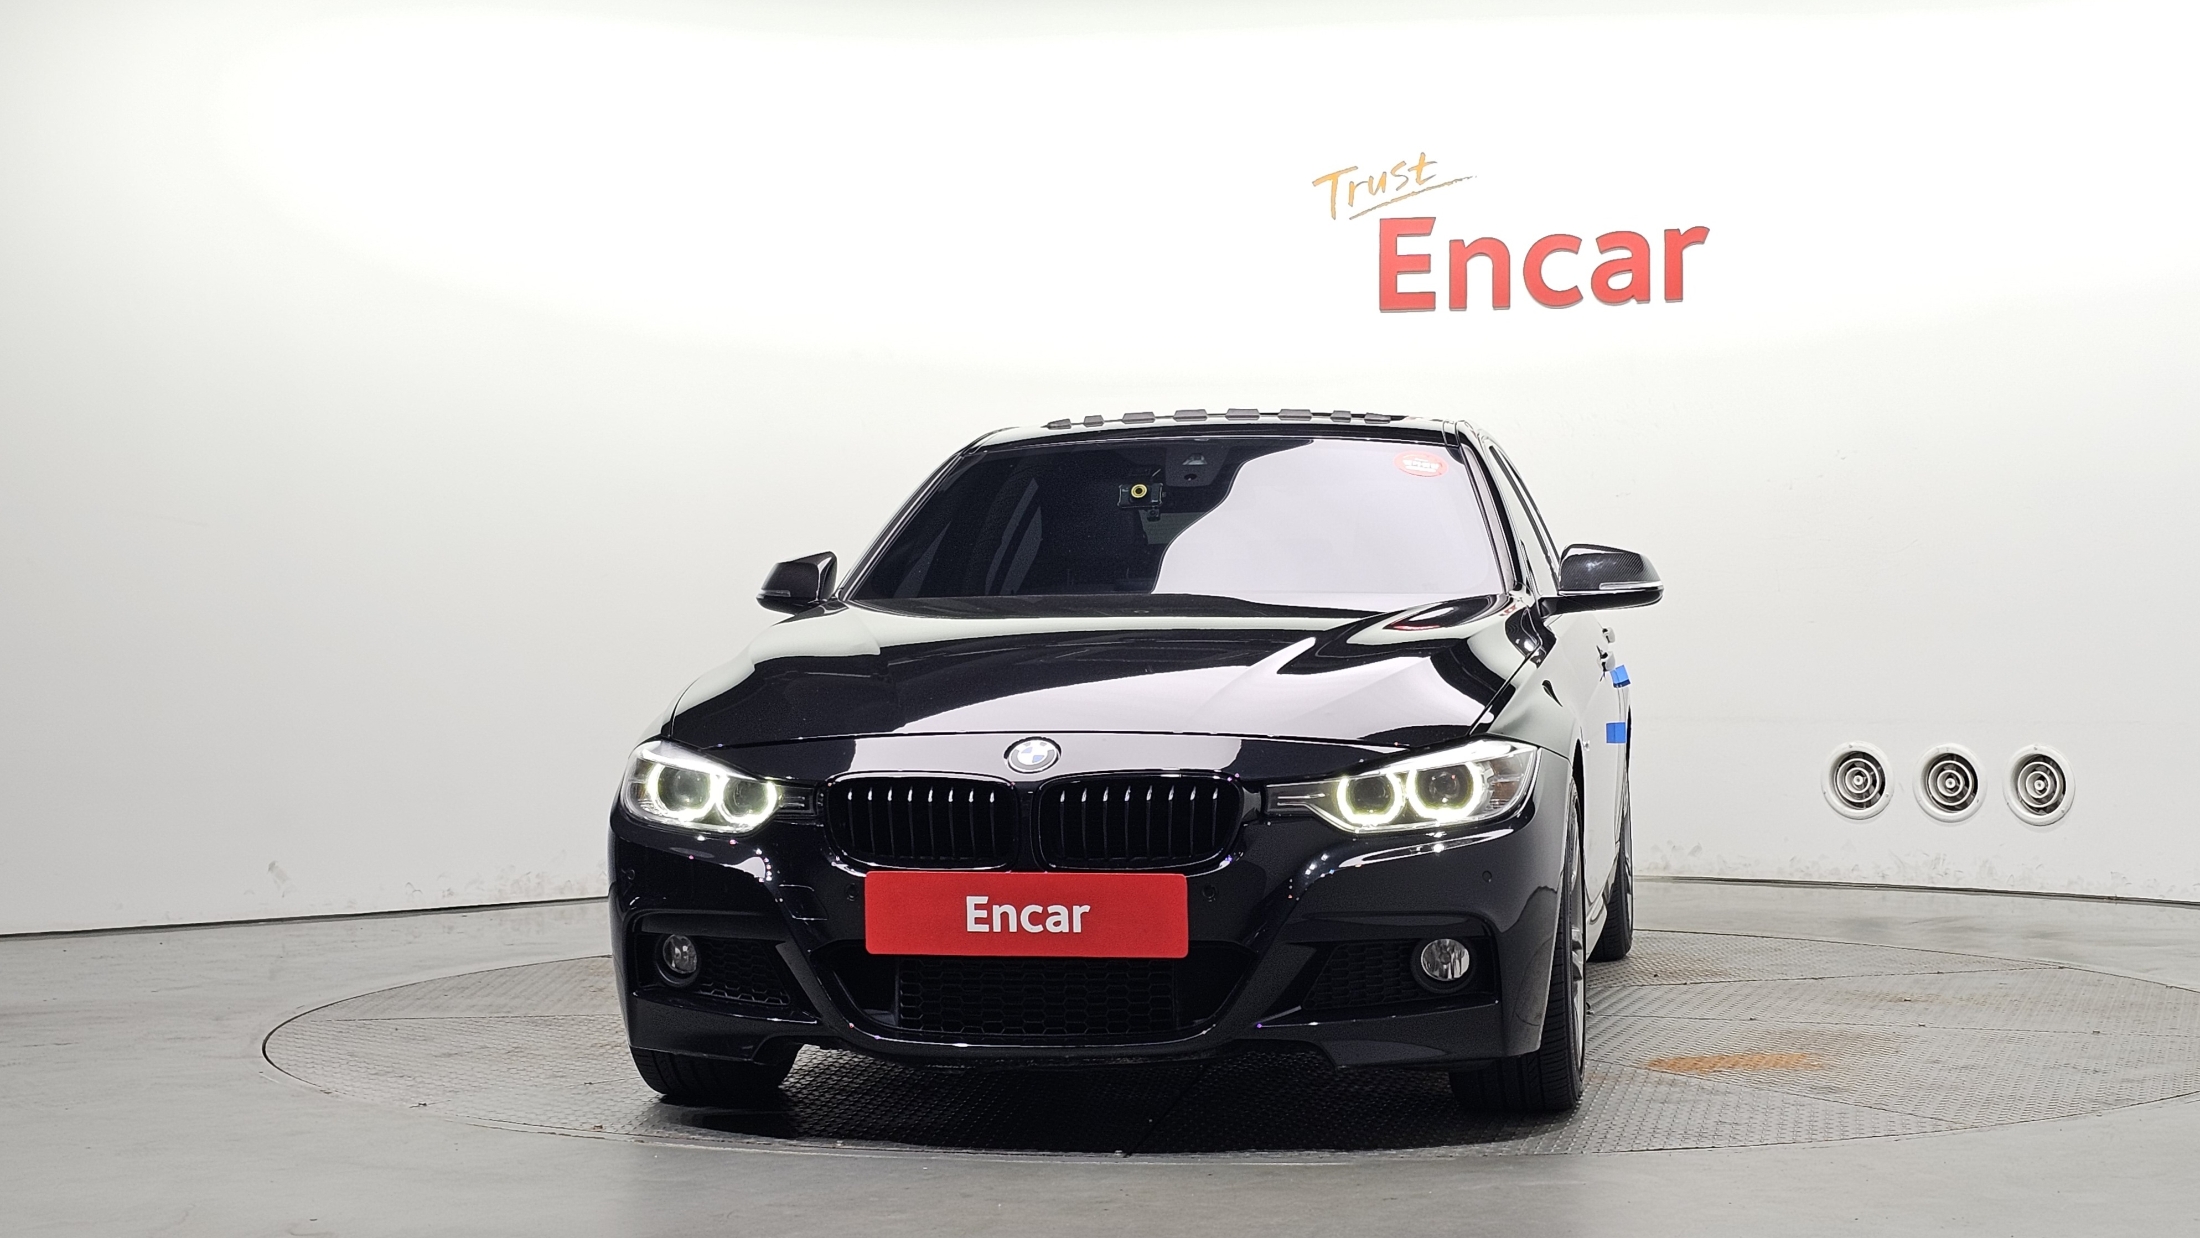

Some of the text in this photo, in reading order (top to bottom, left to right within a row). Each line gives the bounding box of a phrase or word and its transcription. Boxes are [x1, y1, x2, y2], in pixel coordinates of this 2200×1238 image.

[1312, 152, 1438, 220] Trust
[1379, 216, 1710, 312] Encar
[966, 895, 1091, 933] Encar
